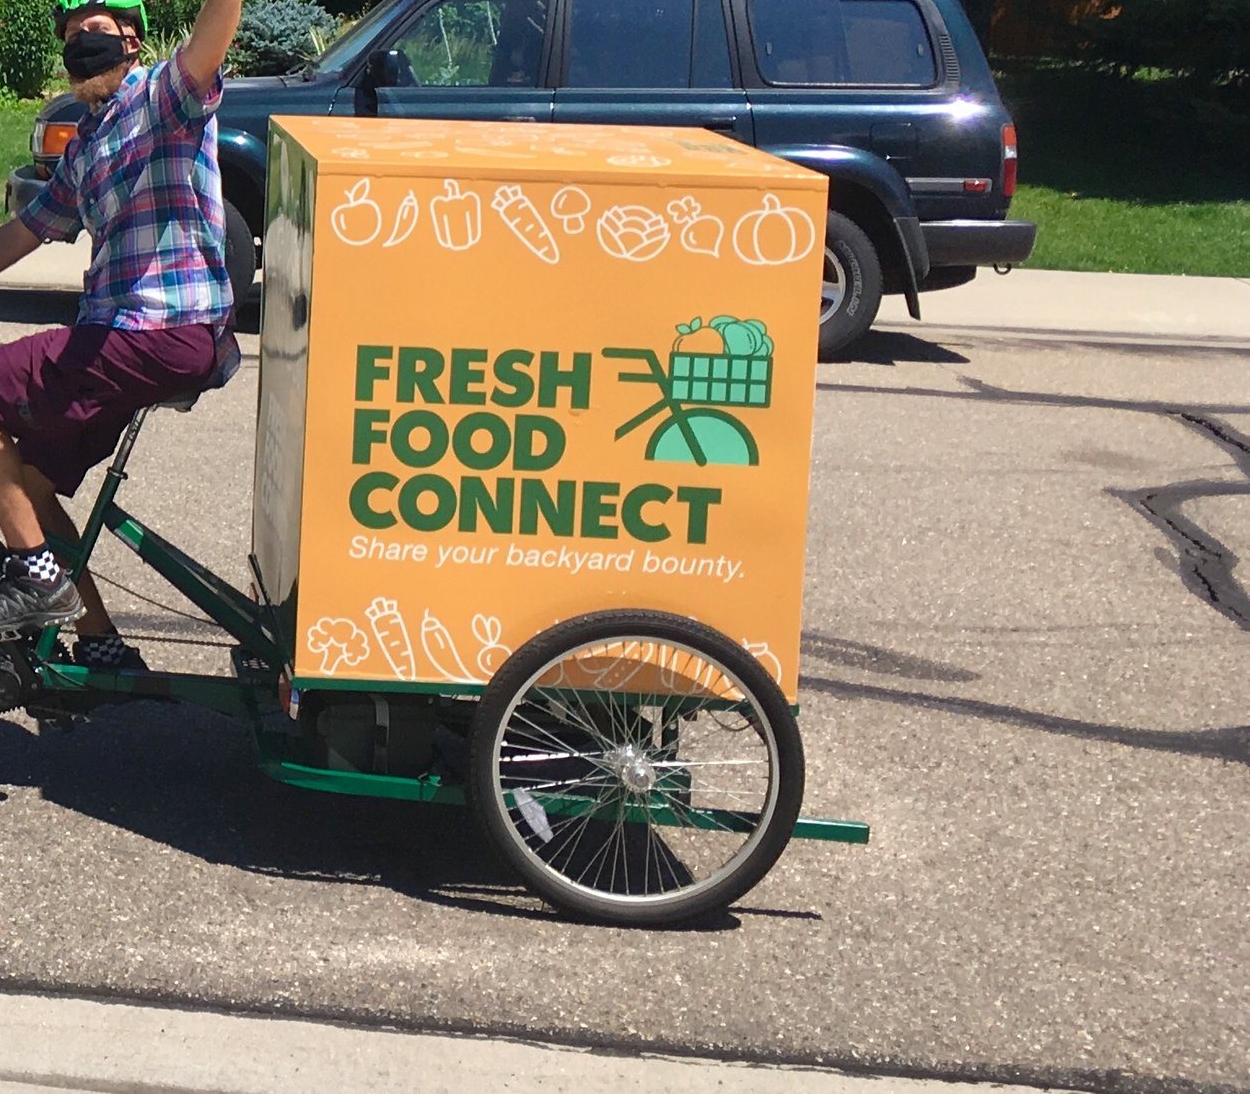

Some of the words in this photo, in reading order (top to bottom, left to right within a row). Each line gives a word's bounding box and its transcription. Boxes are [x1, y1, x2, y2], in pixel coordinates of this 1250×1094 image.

[355, 345, 592, 409] FRESH
[352, 409, 567, 471] FOOD
[348, 472, 722, 544] CONNECT
[348, 535, 428, 562] Share
[434, 544, 495, 568] your
[505, 543, 635, 575] backyard
[642, 549, 745, 583] bounty.
